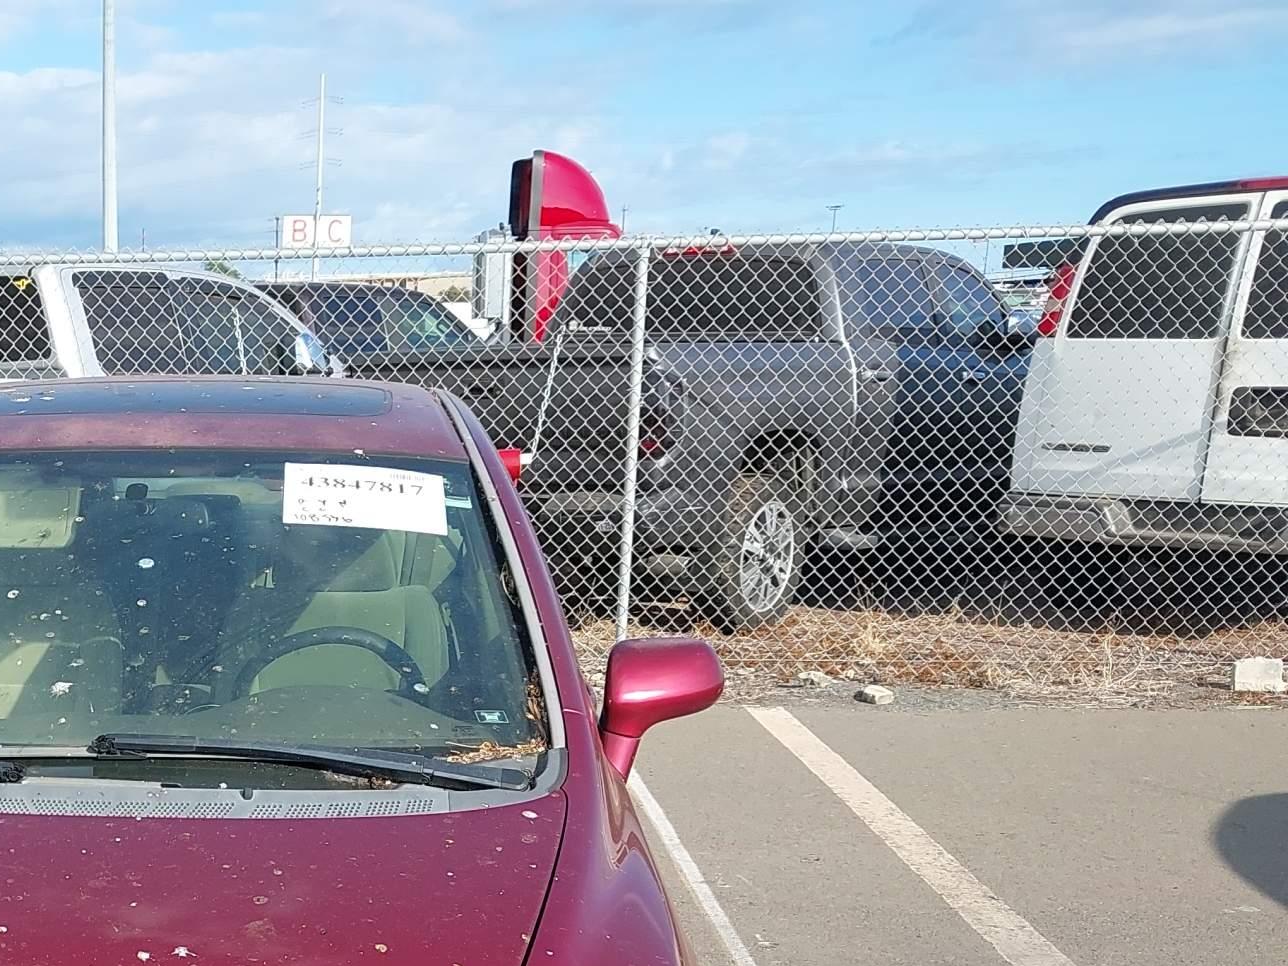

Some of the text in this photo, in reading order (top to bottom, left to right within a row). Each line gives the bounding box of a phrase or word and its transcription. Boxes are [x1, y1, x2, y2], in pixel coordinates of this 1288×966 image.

[292, 219, 344, 242] B C
[300, 475, 424, 496] 43847817
